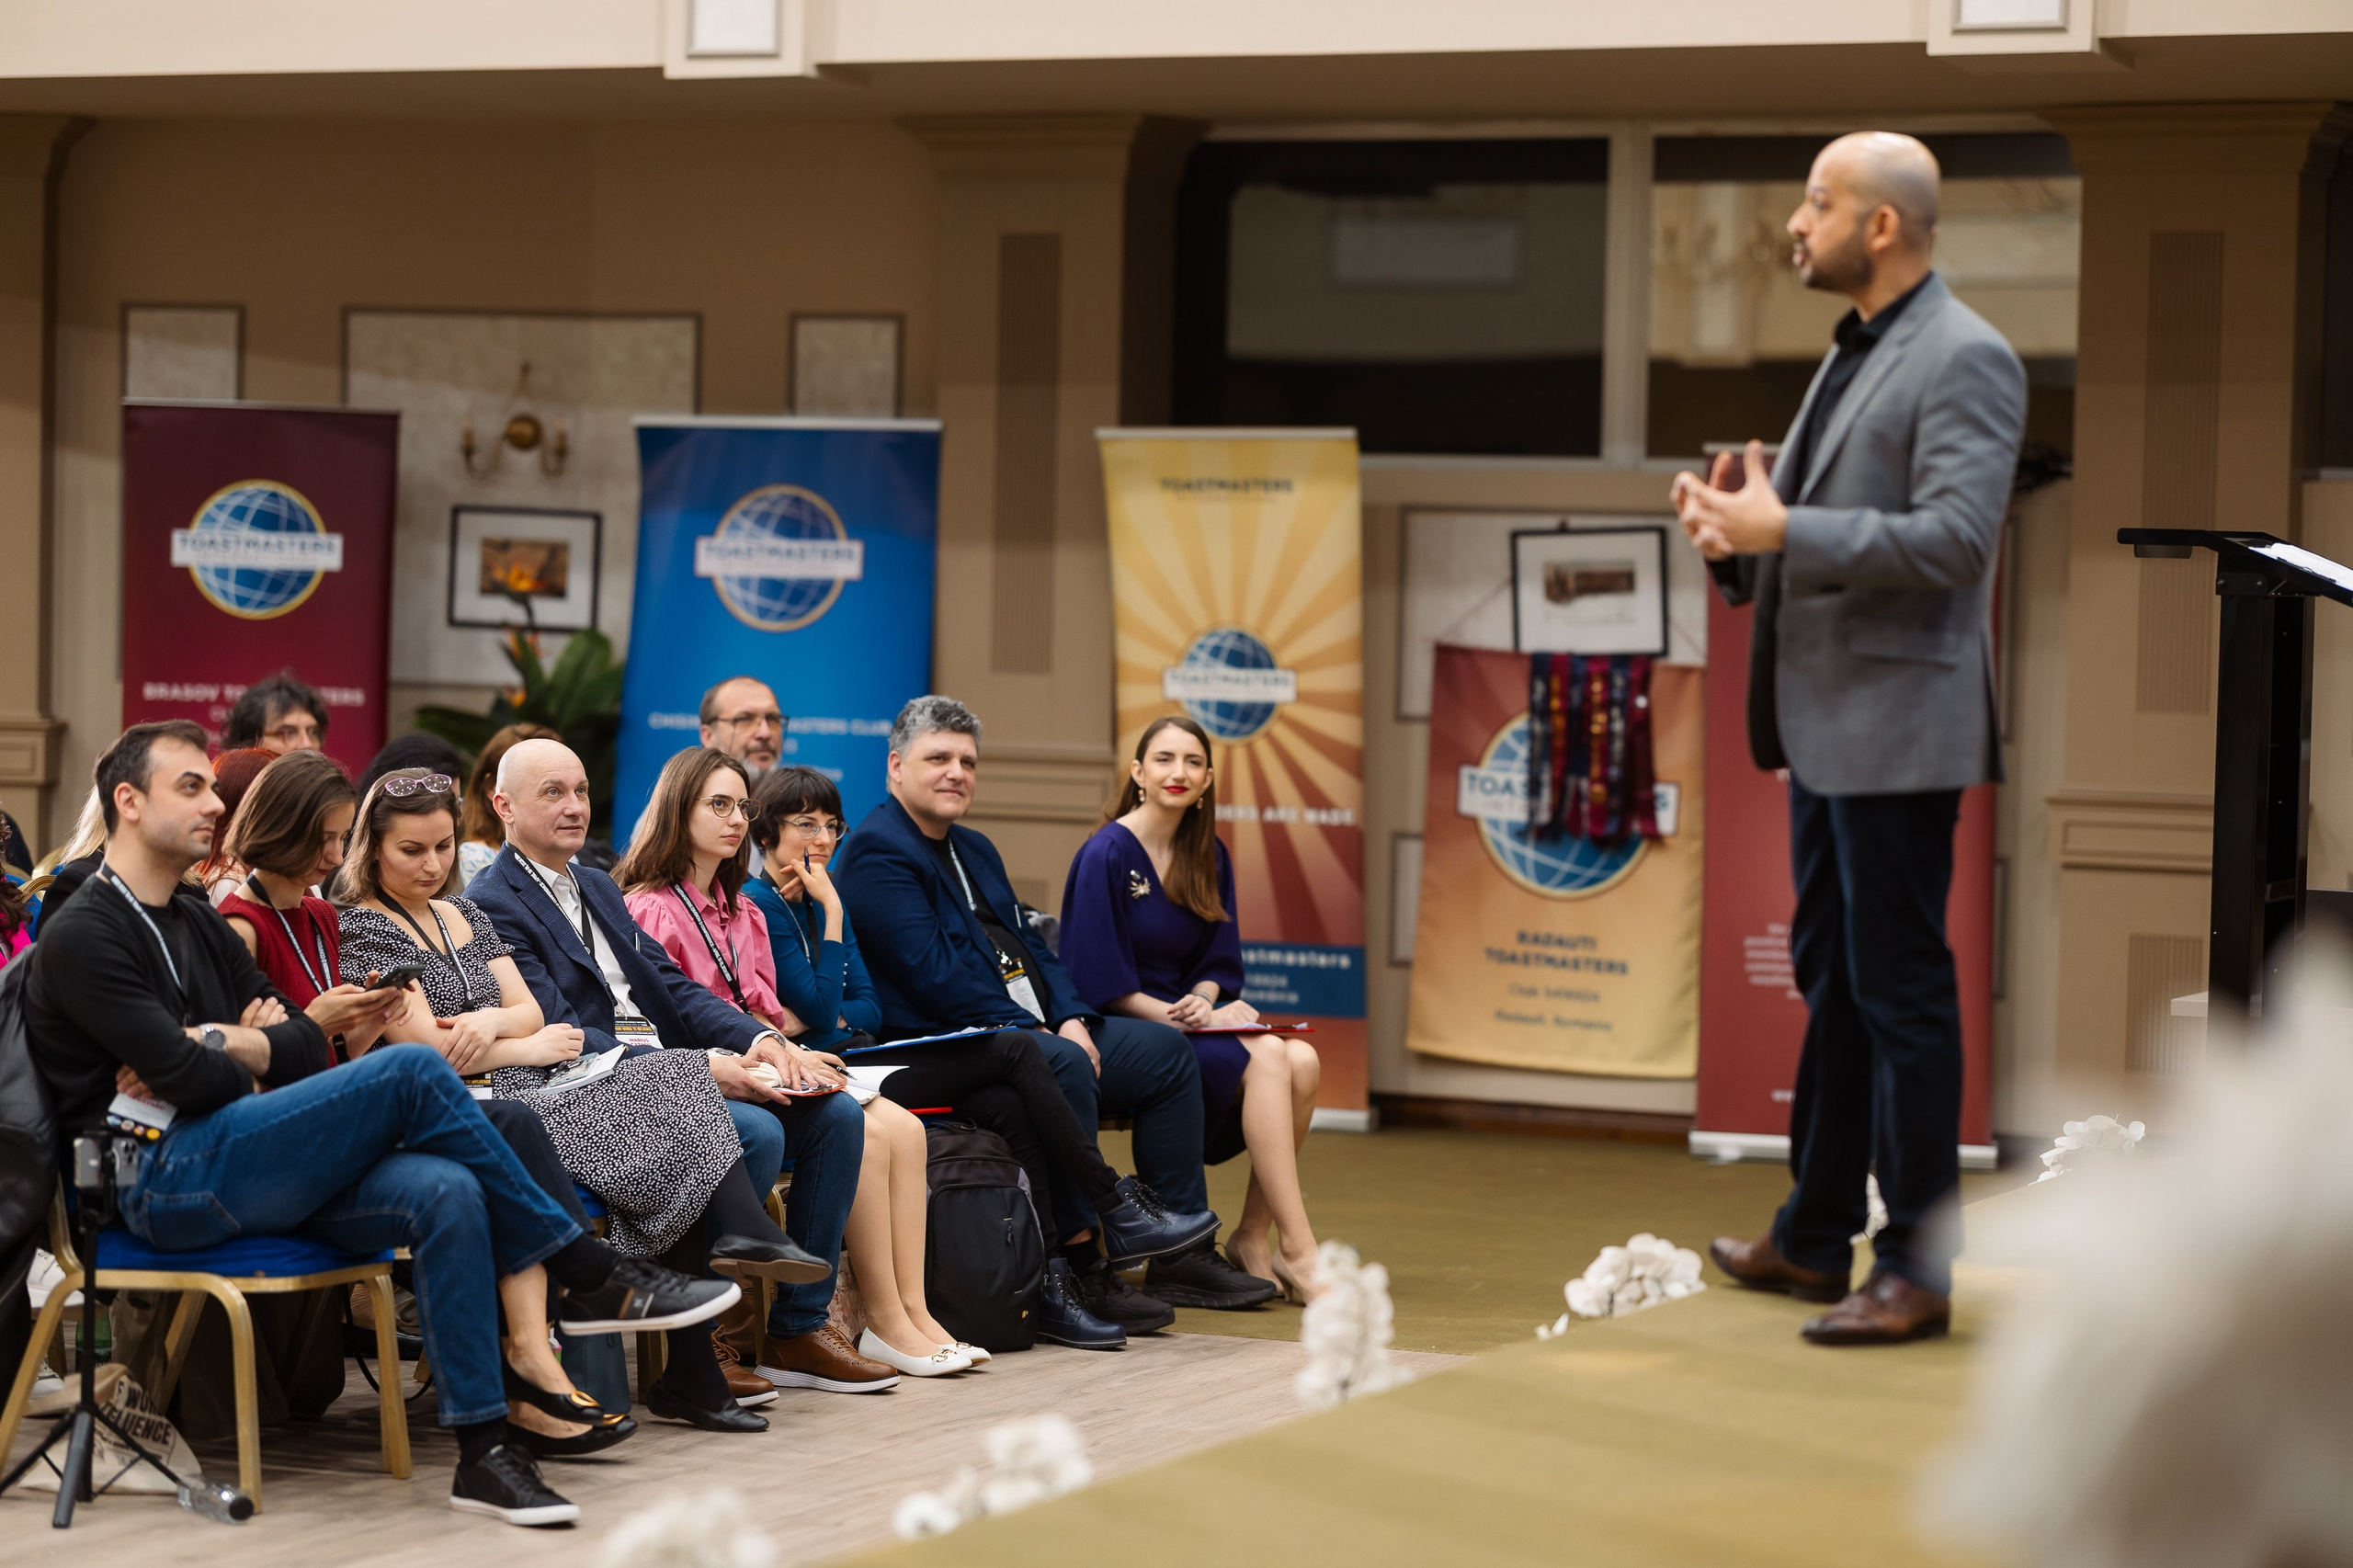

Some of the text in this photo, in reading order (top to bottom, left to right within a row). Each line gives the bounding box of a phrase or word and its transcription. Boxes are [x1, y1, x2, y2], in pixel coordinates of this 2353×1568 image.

[1161, 477, 1294, 494] TOASTMASTERS
[179, 535, 336, 553] TOASTMASTERS
[705, 543, 854, 561] TOASTMASTERS
[1170, 672, 1289, 687] TOASTMASTERS
[1484, 947, 1630, 975] TOASTMASTERS
